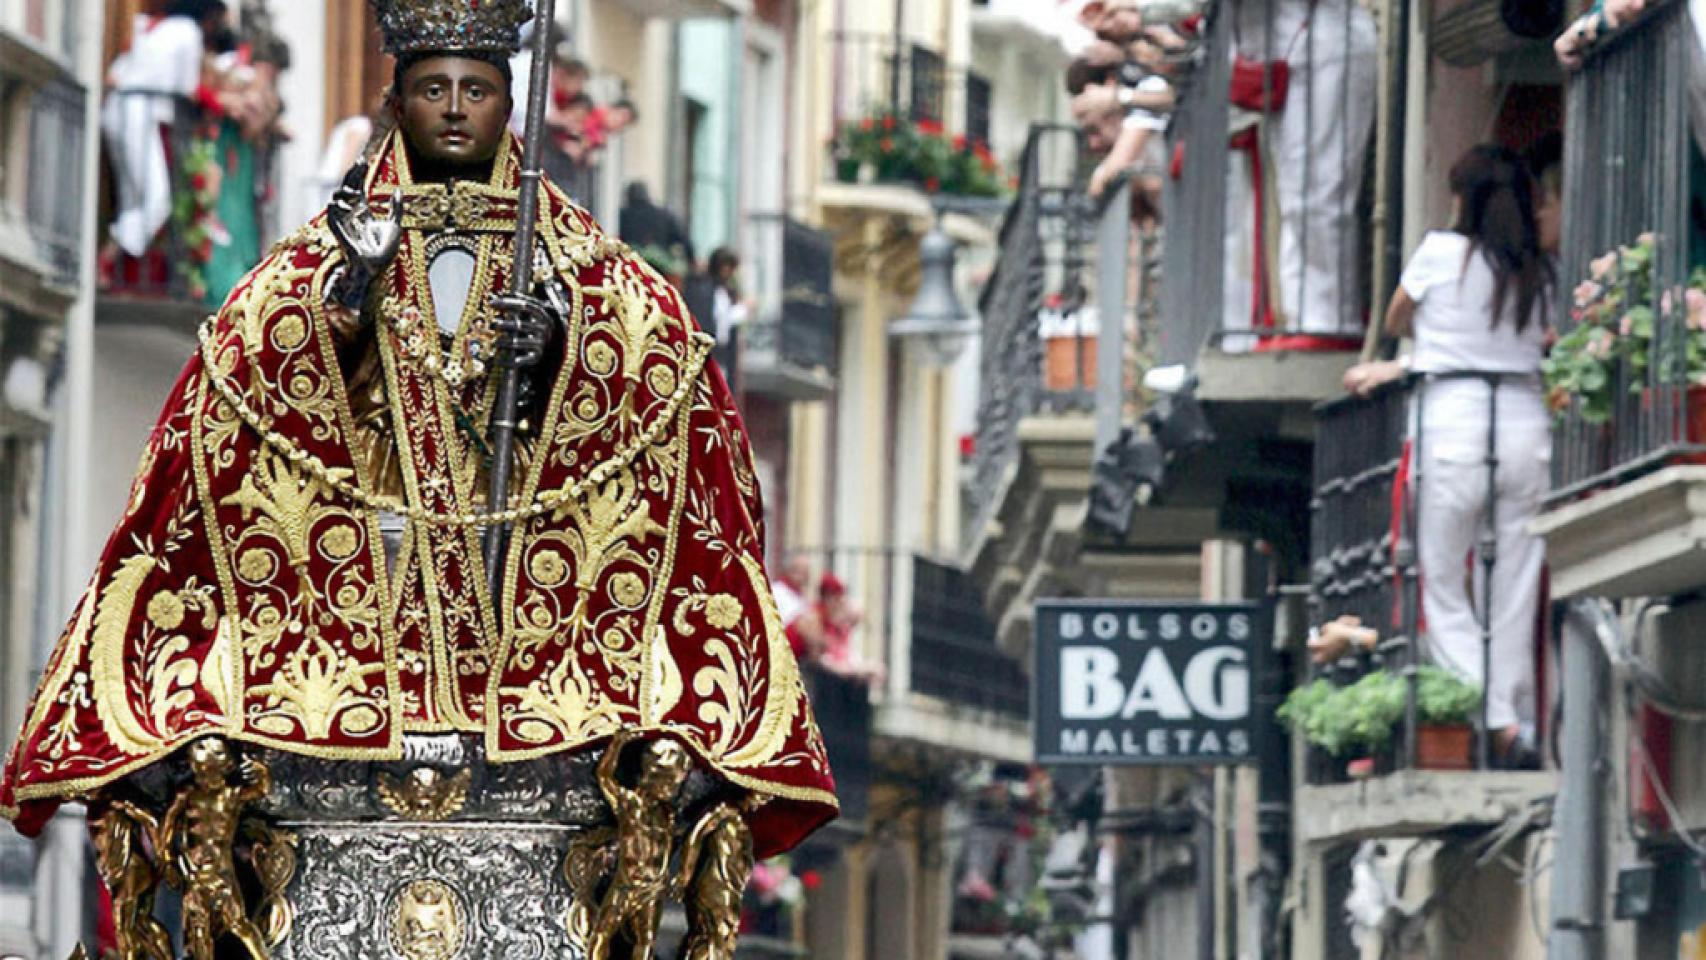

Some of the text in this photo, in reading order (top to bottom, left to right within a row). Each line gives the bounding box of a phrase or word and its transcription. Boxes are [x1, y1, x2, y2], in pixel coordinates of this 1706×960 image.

[1059, 613, 1249, 640] BOLSOS
[1059, 645, 1250, 721] BAG
[1059, 728, 1248, 755] MALETAS
